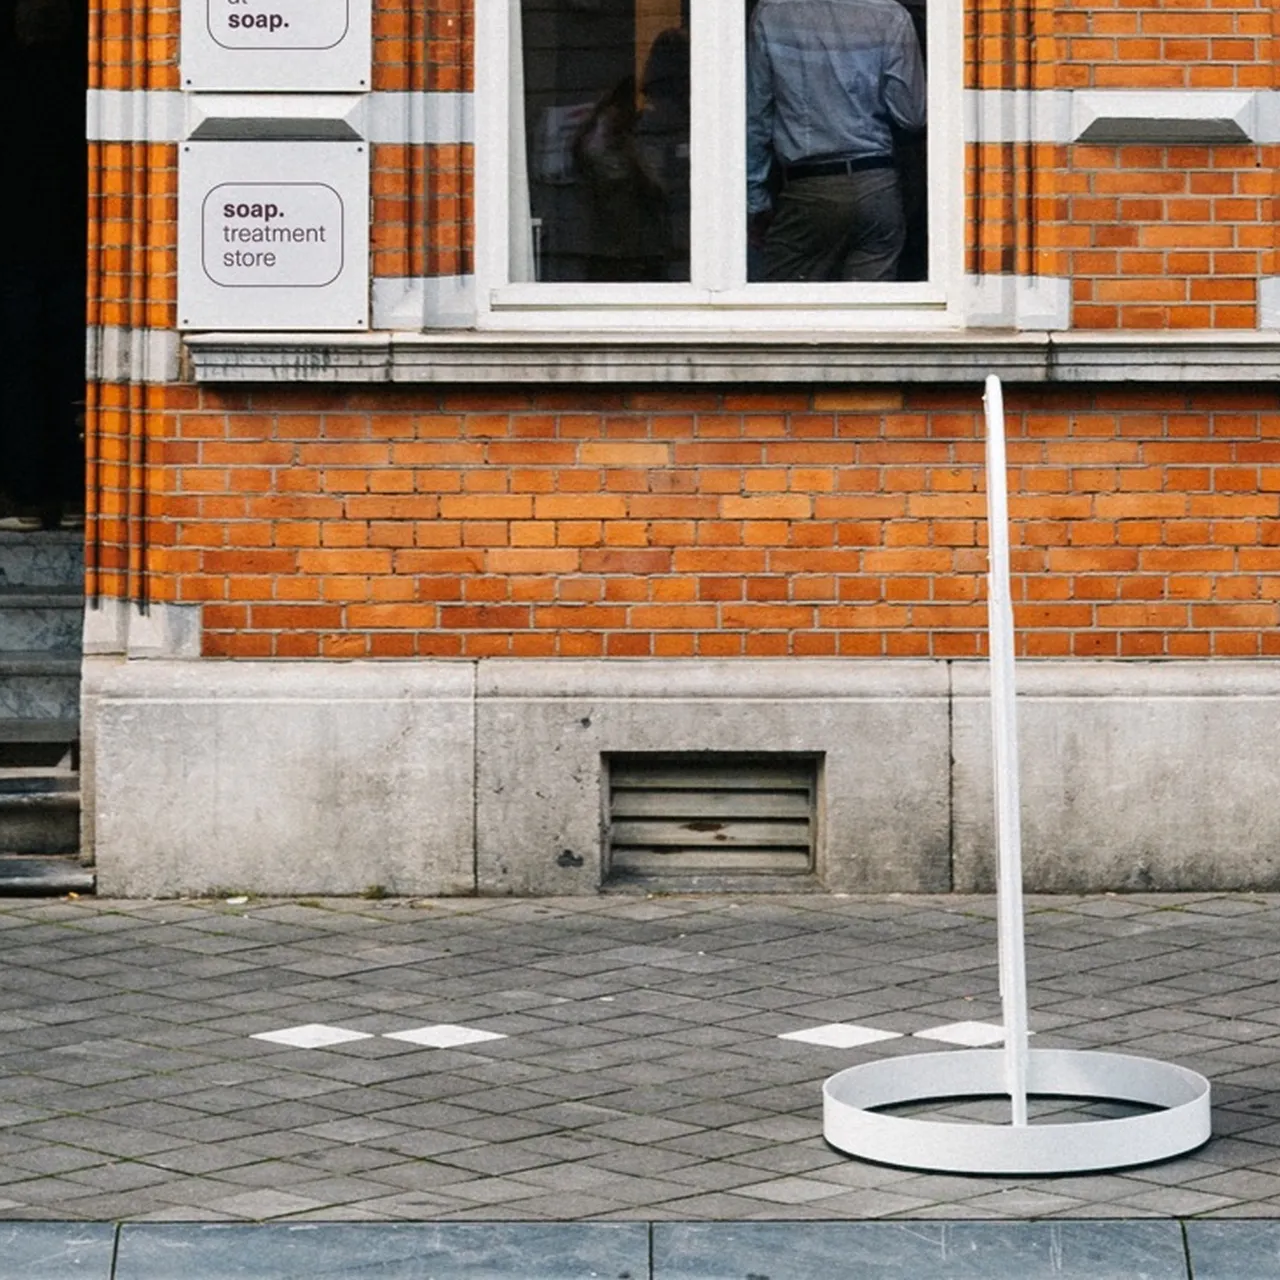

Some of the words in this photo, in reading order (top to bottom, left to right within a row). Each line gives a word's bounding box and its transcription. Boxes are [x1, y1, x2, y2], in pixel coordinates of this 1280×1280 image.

[227, 13, 290, 32] soap.
[222, 203, 285, 221] soap.
[222, 225, 326, 243] treatment
[222, 250, 277, 267] store
